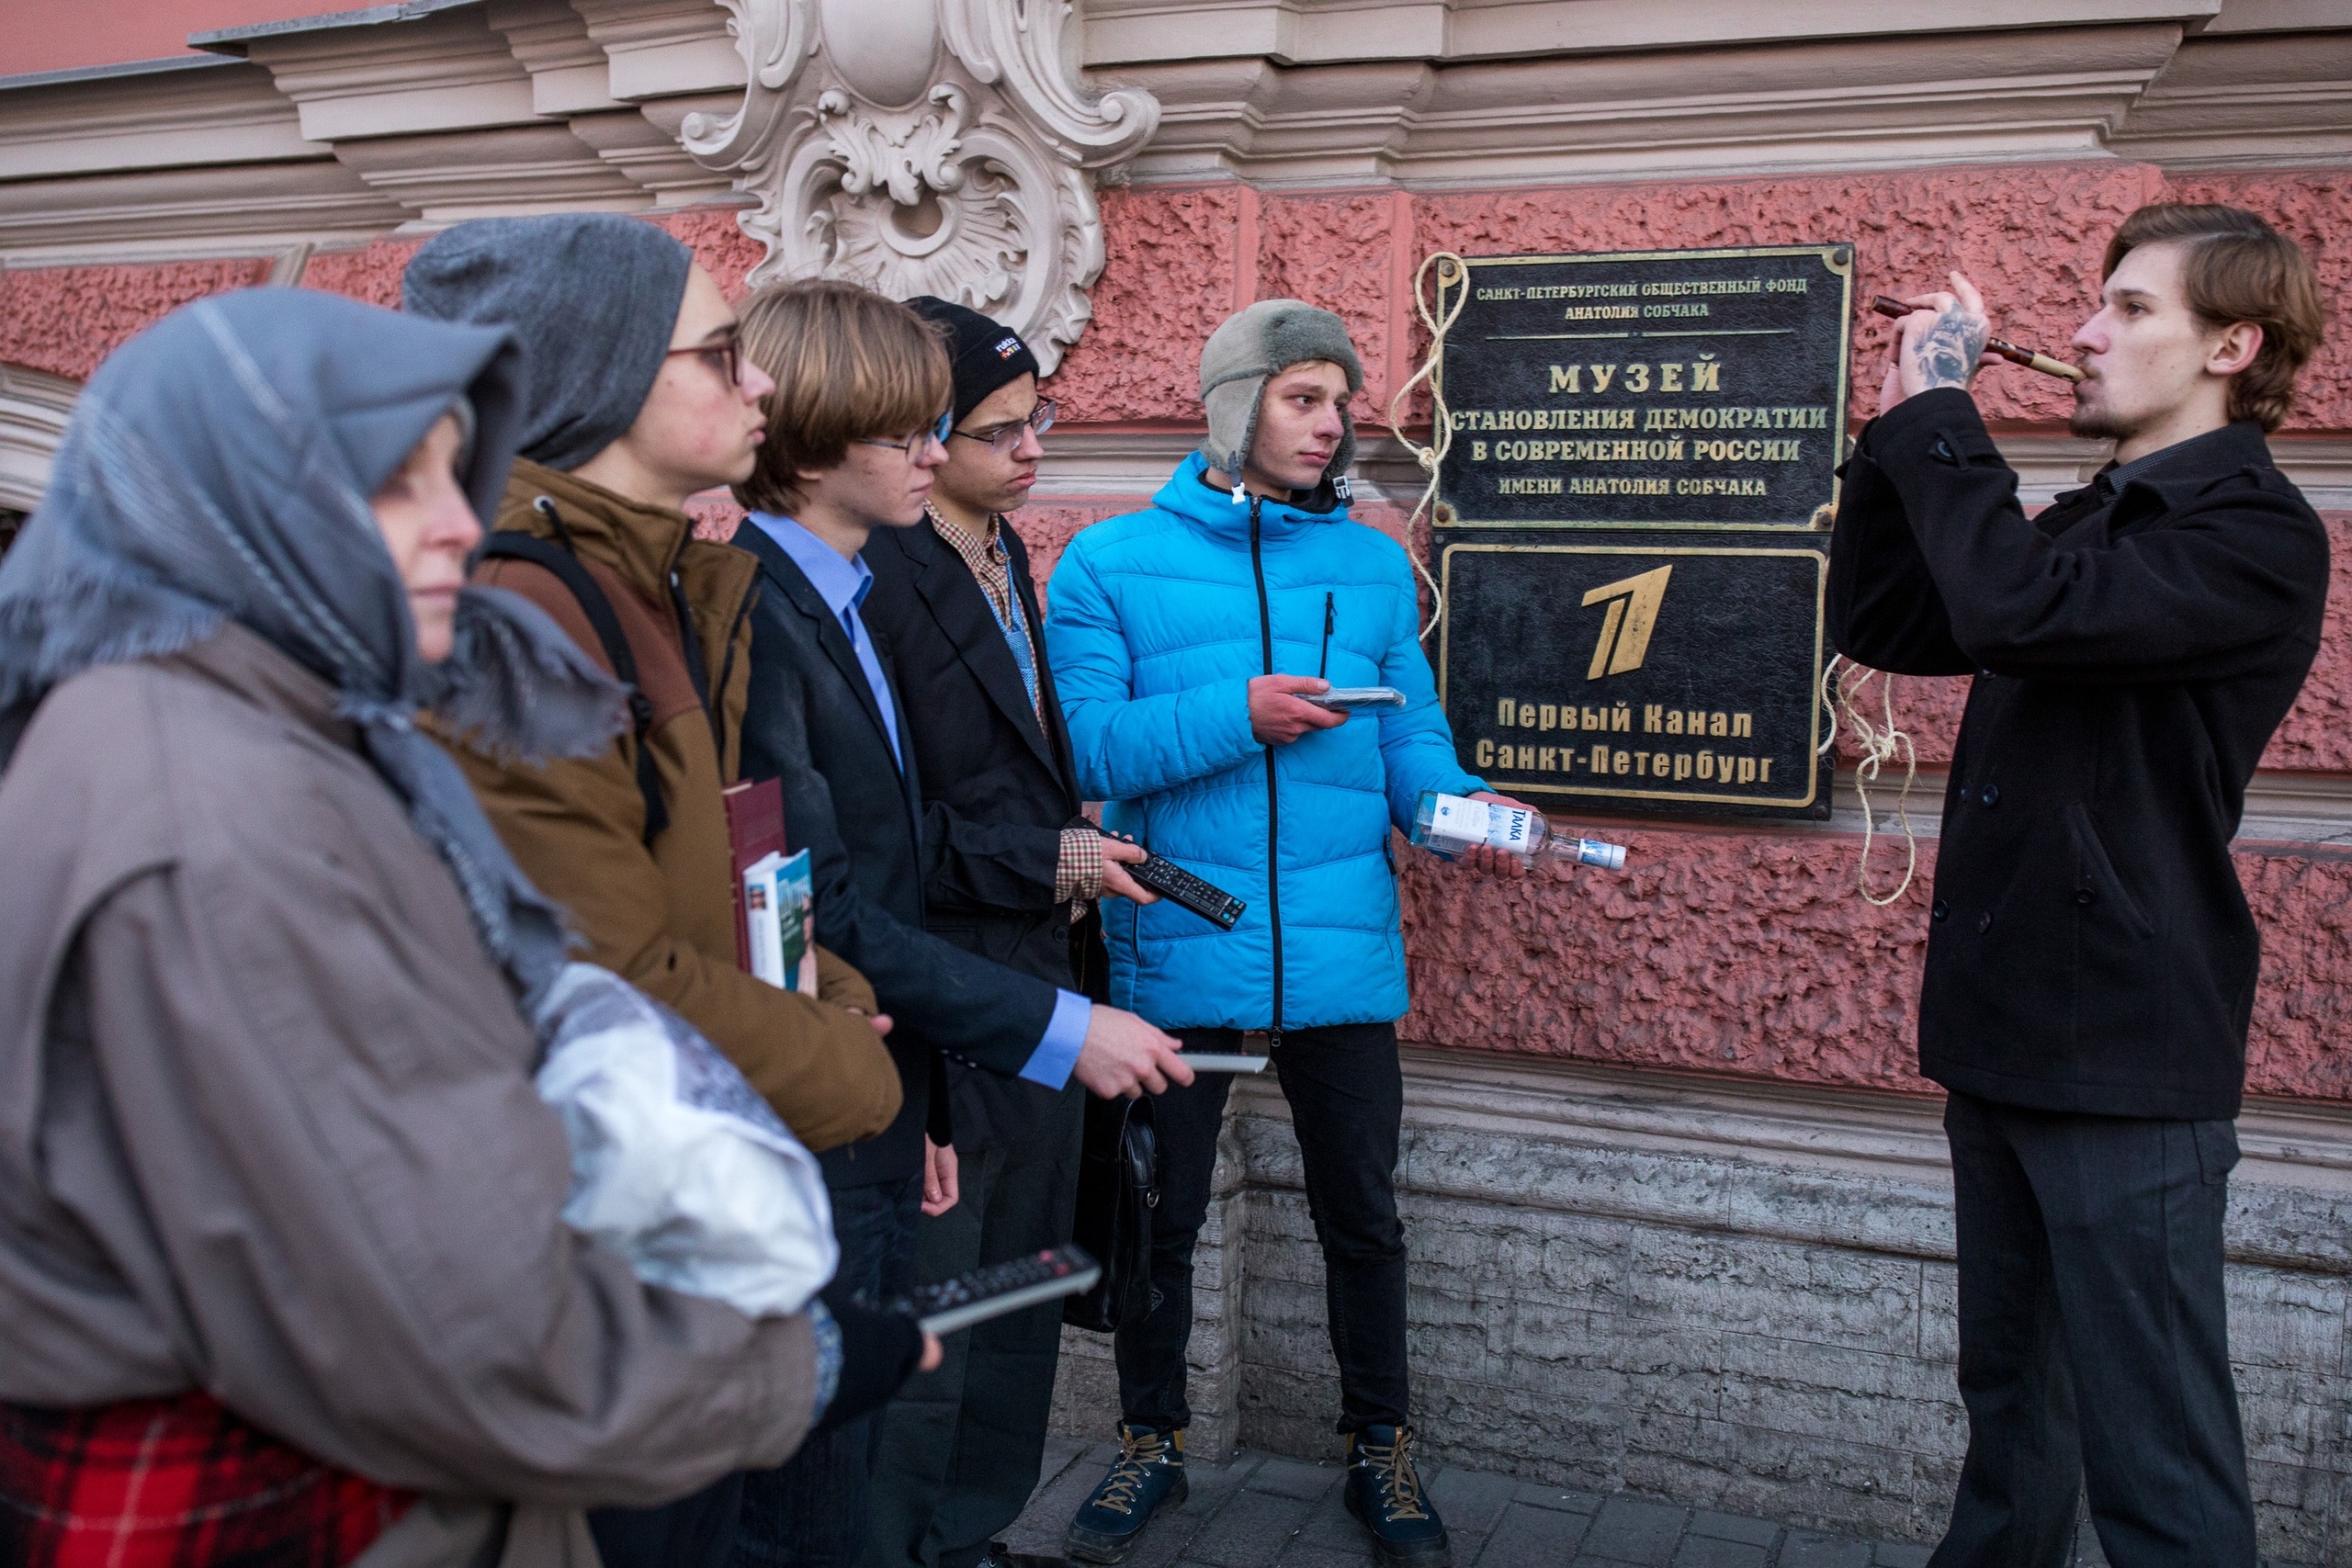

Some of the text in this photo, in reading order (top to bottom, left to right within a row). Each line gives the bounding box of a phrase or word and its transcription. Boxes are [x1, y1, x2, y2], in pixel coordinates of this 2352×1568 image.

[1476, 276, 1807, 301] САНКТ-ПЕТЕРБУРГСКИЙ ОБЩЕСТВЕННЫЙ ФОНД
[1565, 304, 1709, 320] АНАТОЛИЯ СОБЧАКА
[1549, 353, 1721, 393] МУЗЕЙ
[1450, 408, 1827, 433] СТАНОВЛЕНИЯ ДЕМОКРАТИИ
[1473, 435, 1801, 461] В СОВРЕМЕННОЙ РОССИИ
[1498, 478, 1767, 496] ИМЕНИ АНАТОЛИЯ СОБЧАКА
[1498, 698, 1753, 739] Первый Канал
[1476, 739, 1774, 784] Санкт-Петербург
